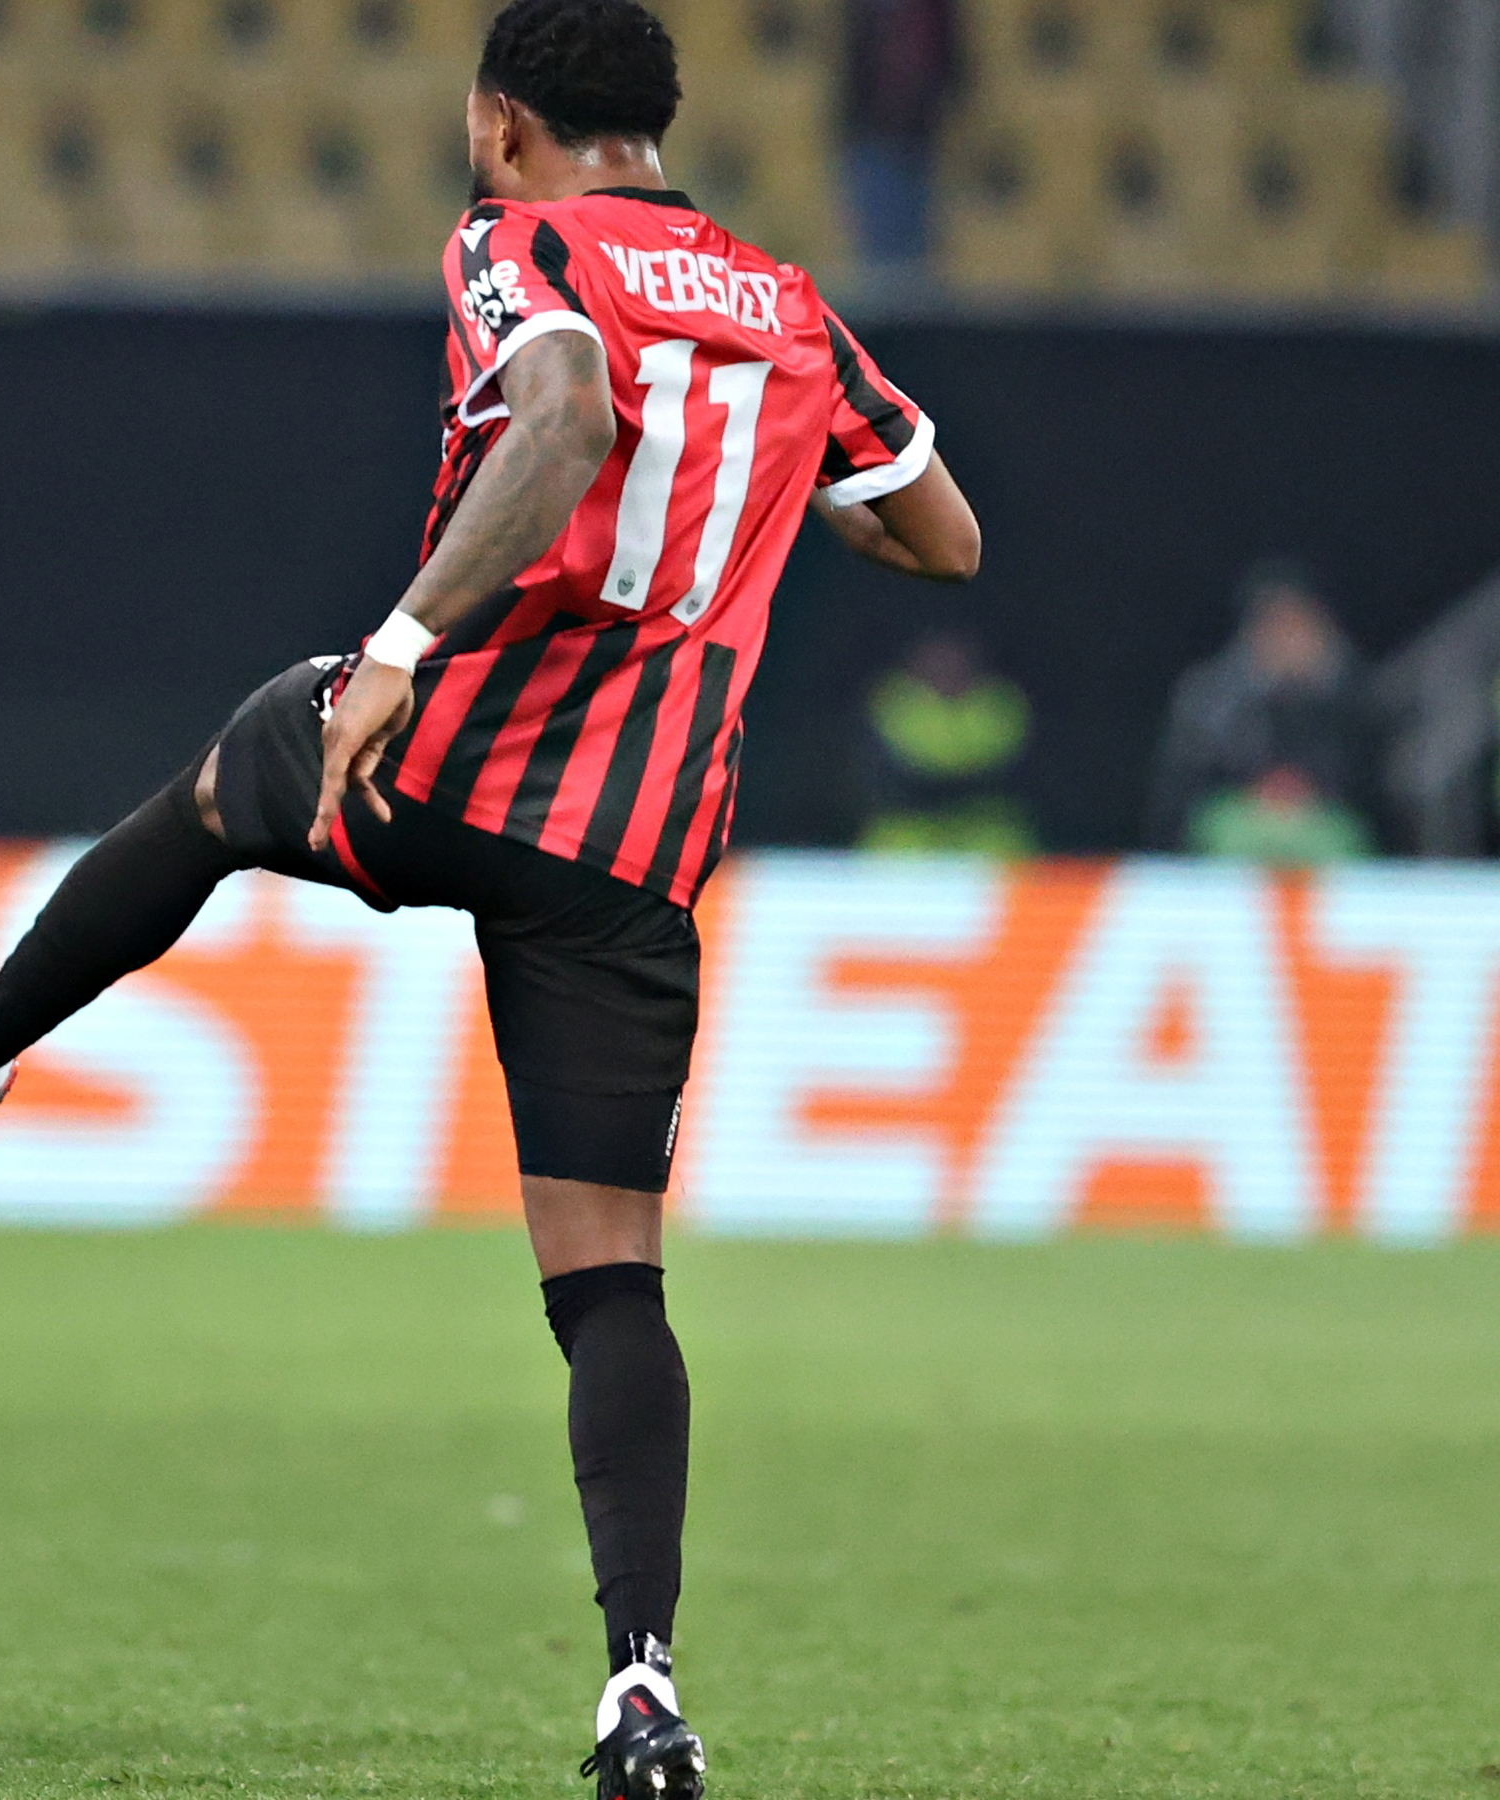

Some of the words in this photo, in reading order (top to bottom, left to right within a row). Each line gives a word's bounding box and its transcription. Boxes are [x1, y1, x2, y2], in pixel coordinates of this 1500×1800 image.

[598, 241, 782, 336] WEBSTER
[599, 338, 774, 626] 11
[682, 850, 1500, 1250] EAT
